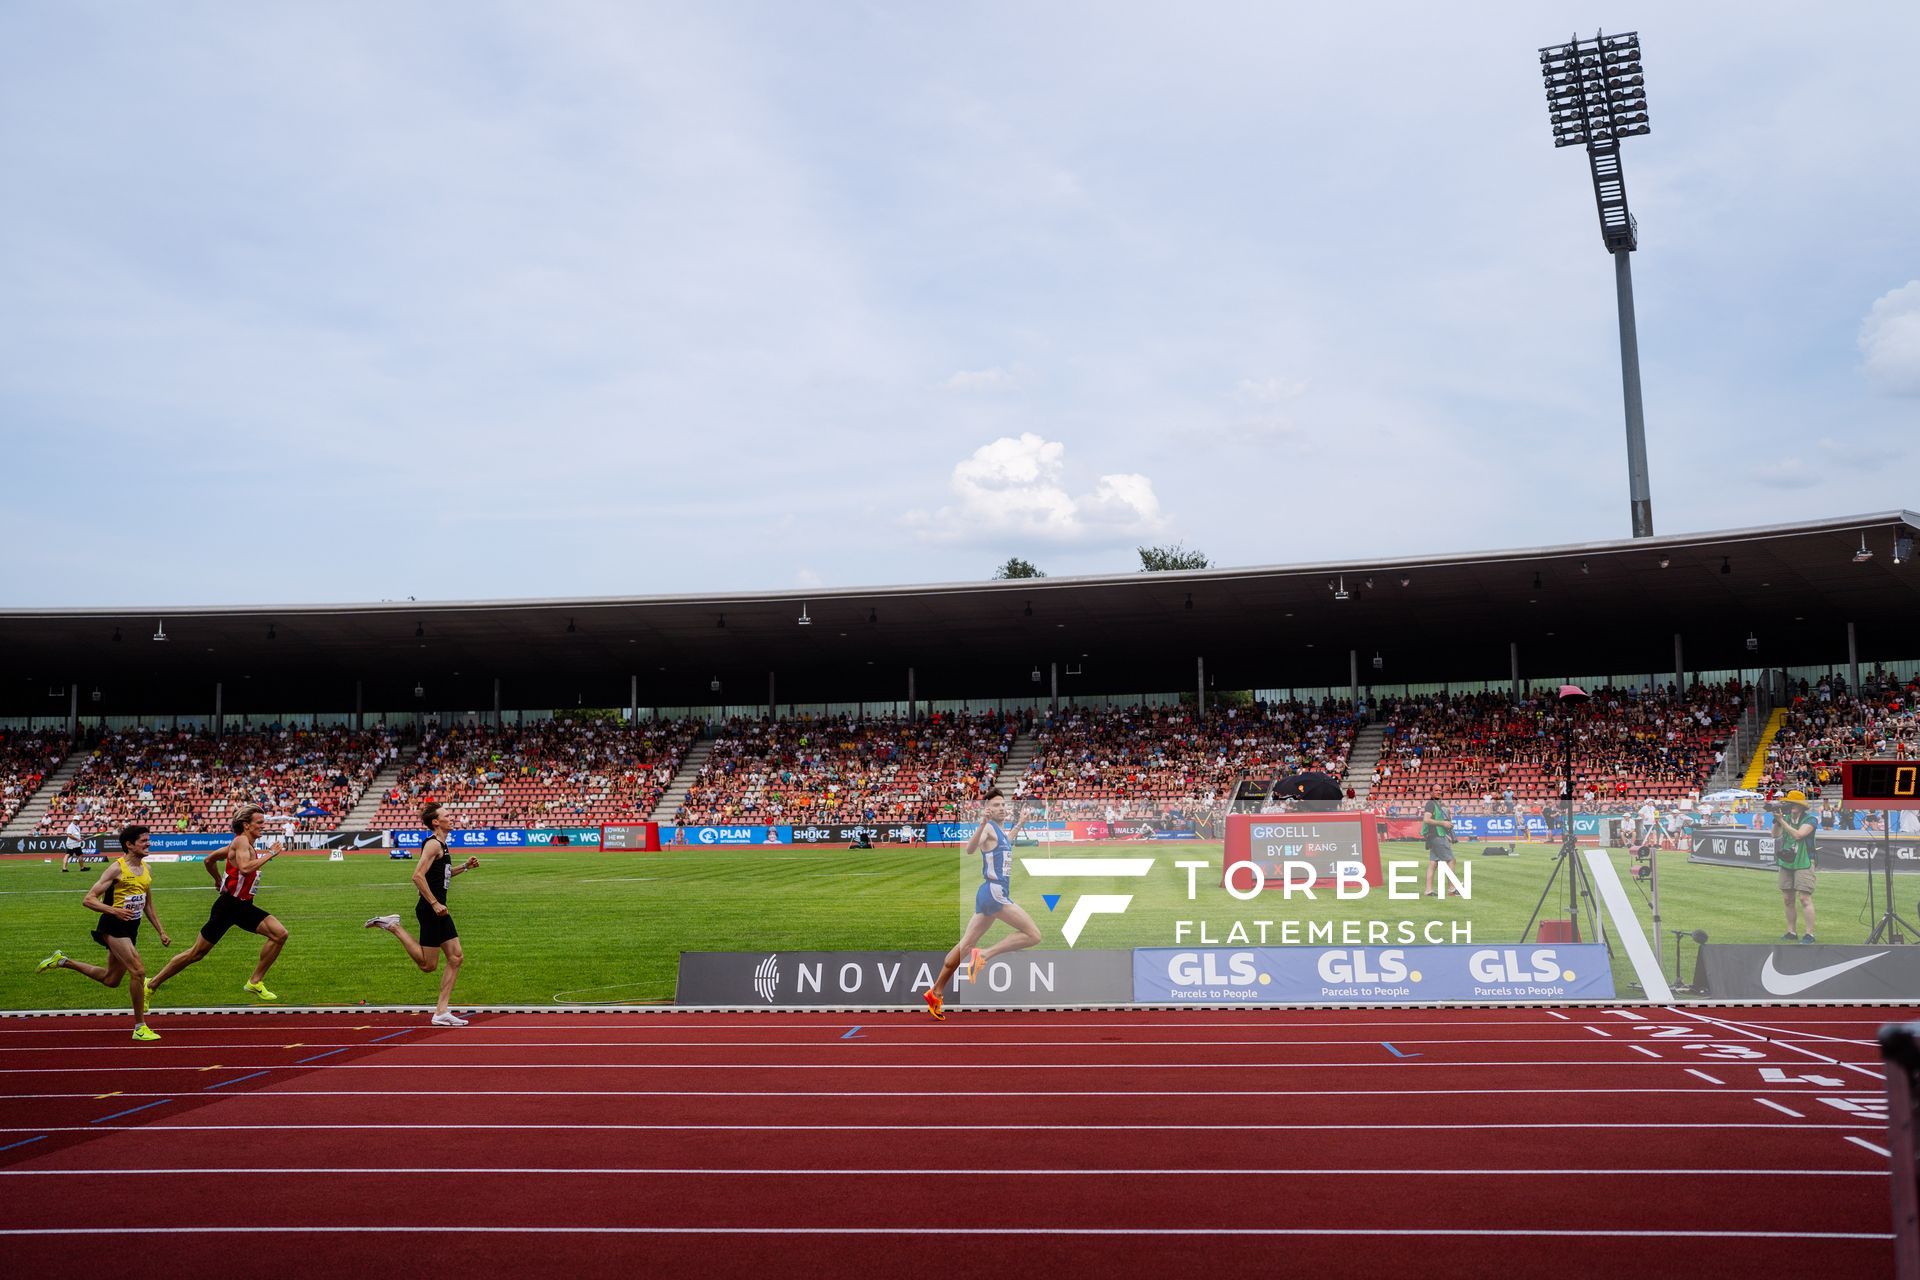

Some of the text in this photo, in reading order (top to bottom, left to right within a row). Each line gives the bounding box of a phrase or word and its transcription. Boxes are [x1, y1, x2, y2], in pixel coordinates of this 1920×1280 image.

[1894, 767, 1917, 795] 0
[720, 829, 751, 839] PLAN
[793, 829, 830, 839] SHOKZ
[888, 828, 925, 838] SHKZ
[1253, 826, 1320, 838] GROELL L
[528, 833, 553, 843] WGV
[1267, 845, 1282, 856] BY
[1308, 843, 1359, 856] RANG 1
[1842, 847, 1879, 859] WGV
[1171, 989, 1258, 1000] Parcels to People
[1322, 987, 1410, 998] Parcels to People
[1475, 986, 1564, 997] Parcels to People
[1632, 1026, 1714, 1037] 2
[1682, 1044, 1766, 1059] 3
